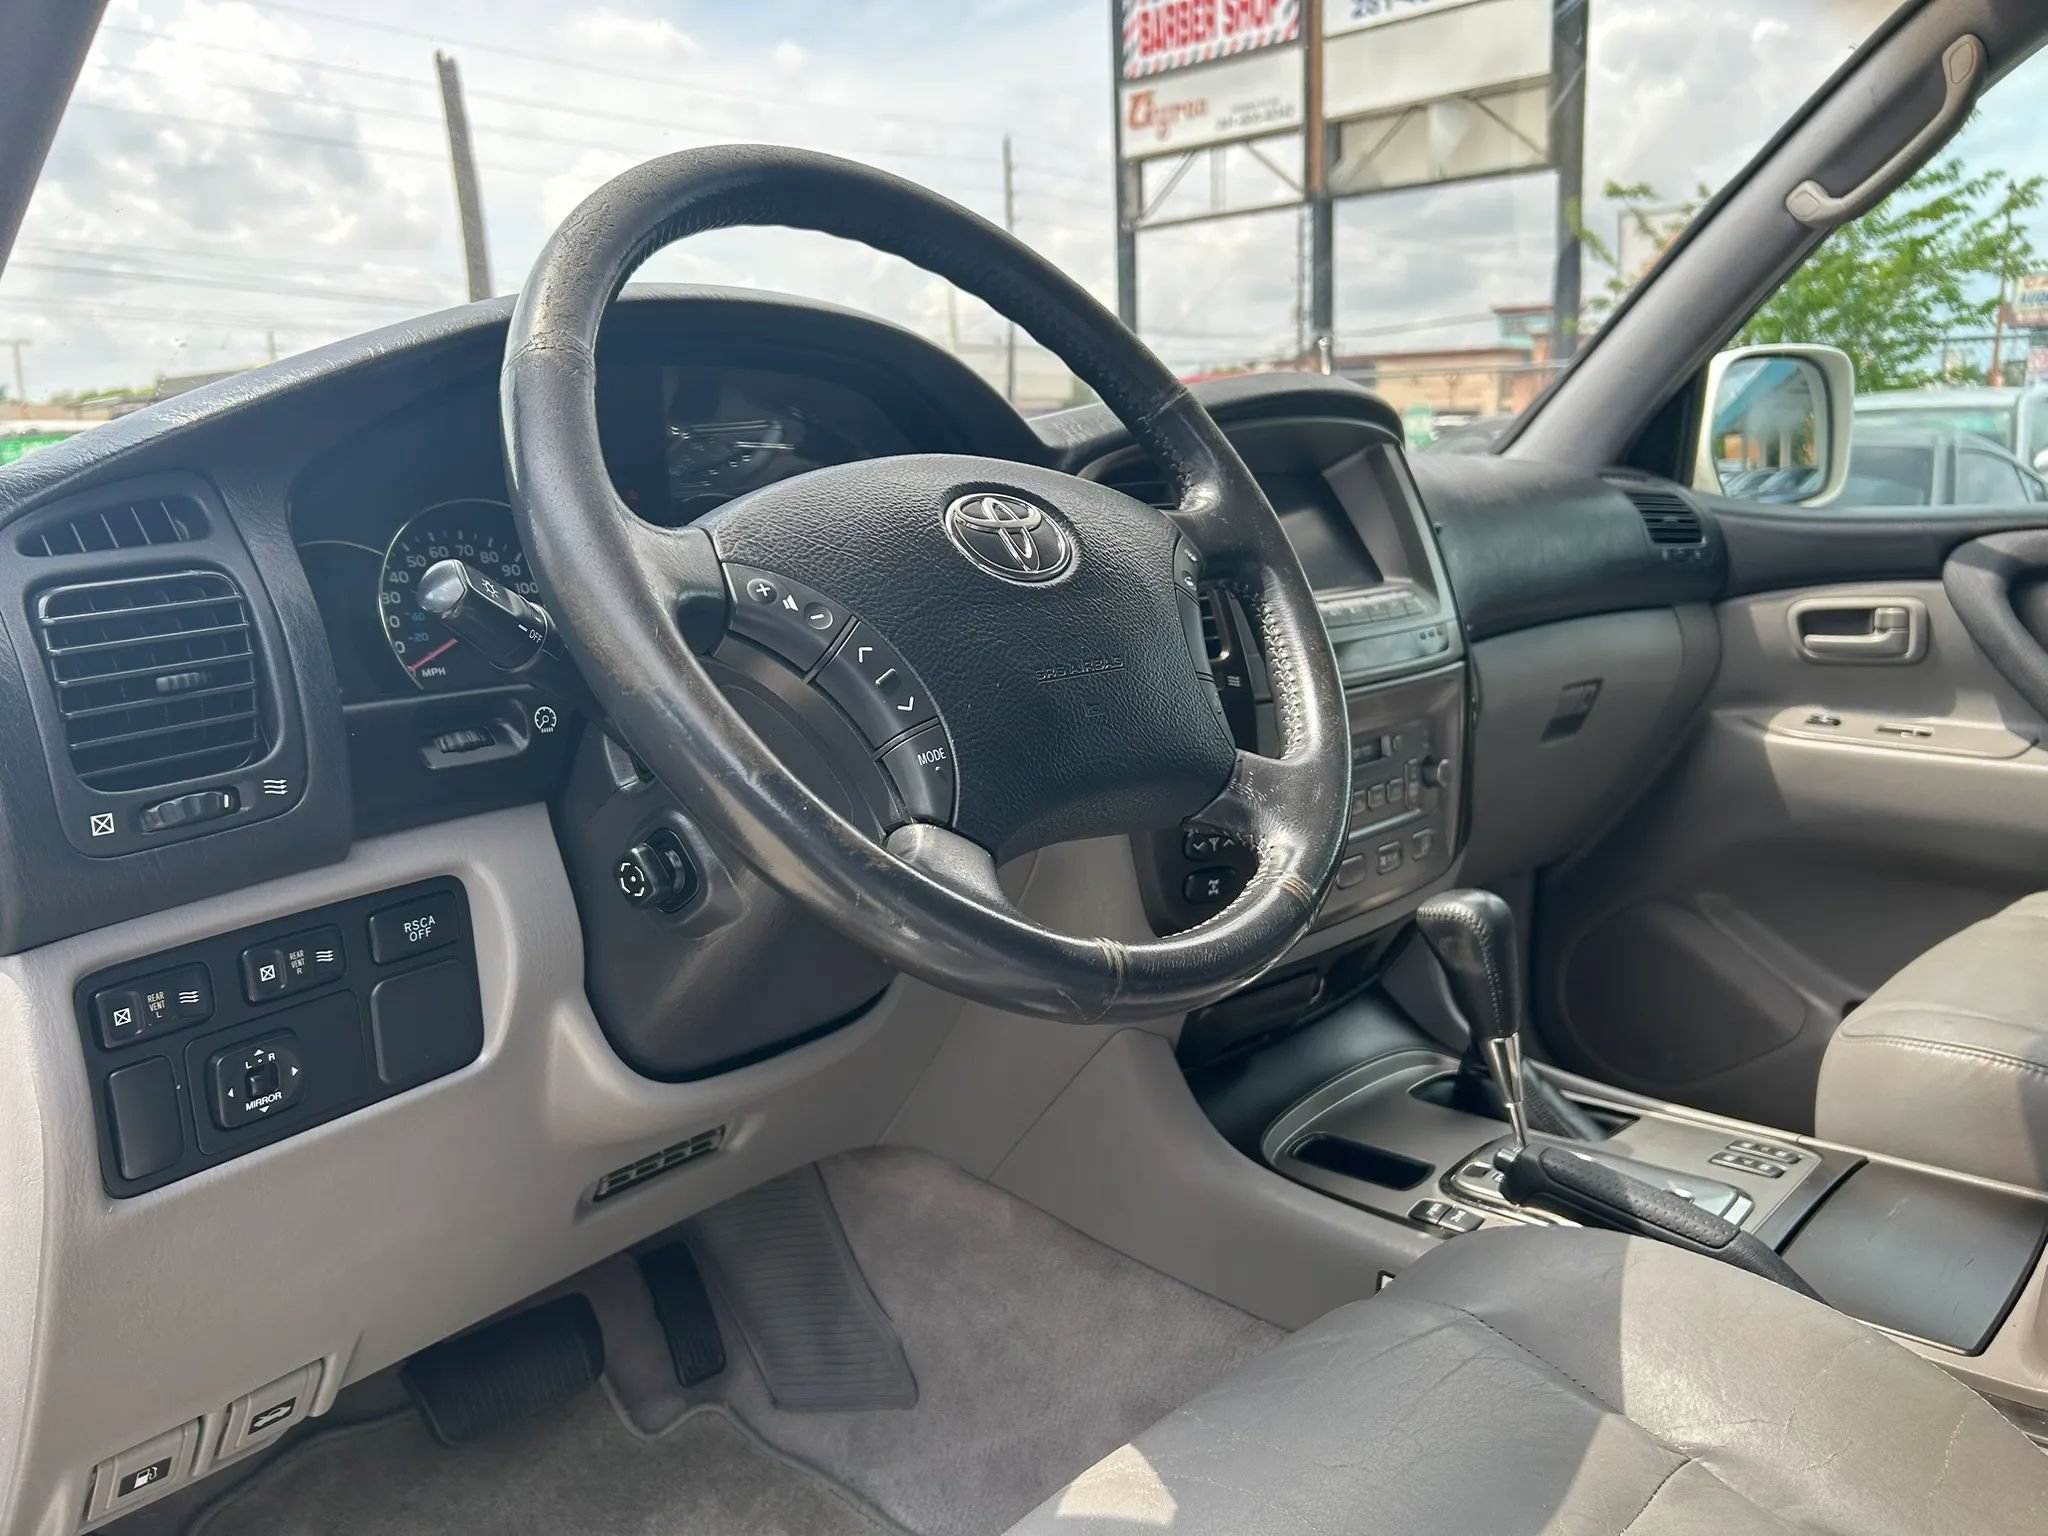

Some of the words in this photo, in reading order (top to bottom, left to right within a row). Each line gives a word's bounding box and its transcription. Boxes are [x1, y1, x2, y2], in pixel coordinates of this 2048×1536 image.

[1139, 0, 1218, 56] BARBER
[429, 545, 449, 559] 60
[455, 544, 474, 557] 70
[480, 551, 499, 564] 80
[406, 554, 427, 568] 50
[389, 570, 409, 584] 40
[501, 564, 521, 577] 90
[514, 582, 539, 595] 100
[381, 591, 401, 605] 30
[529, 629, 543, 643] OFF
[421, 666, 446, 678] MPH
[917, 747, 947, 766] MODE
[403, 915, 436, 933] RSCA
[409, 926, 432, 942] OFF
[296, 967, 303, 975] R
[147, 991, 165, 1003] REAR
[149, 1000, 165, 1012] VENT
[245, 1061, 253, 1070] L
[267, 1052, 276, 1062] R
[245, 1091, 283, 1111] MIRROR
